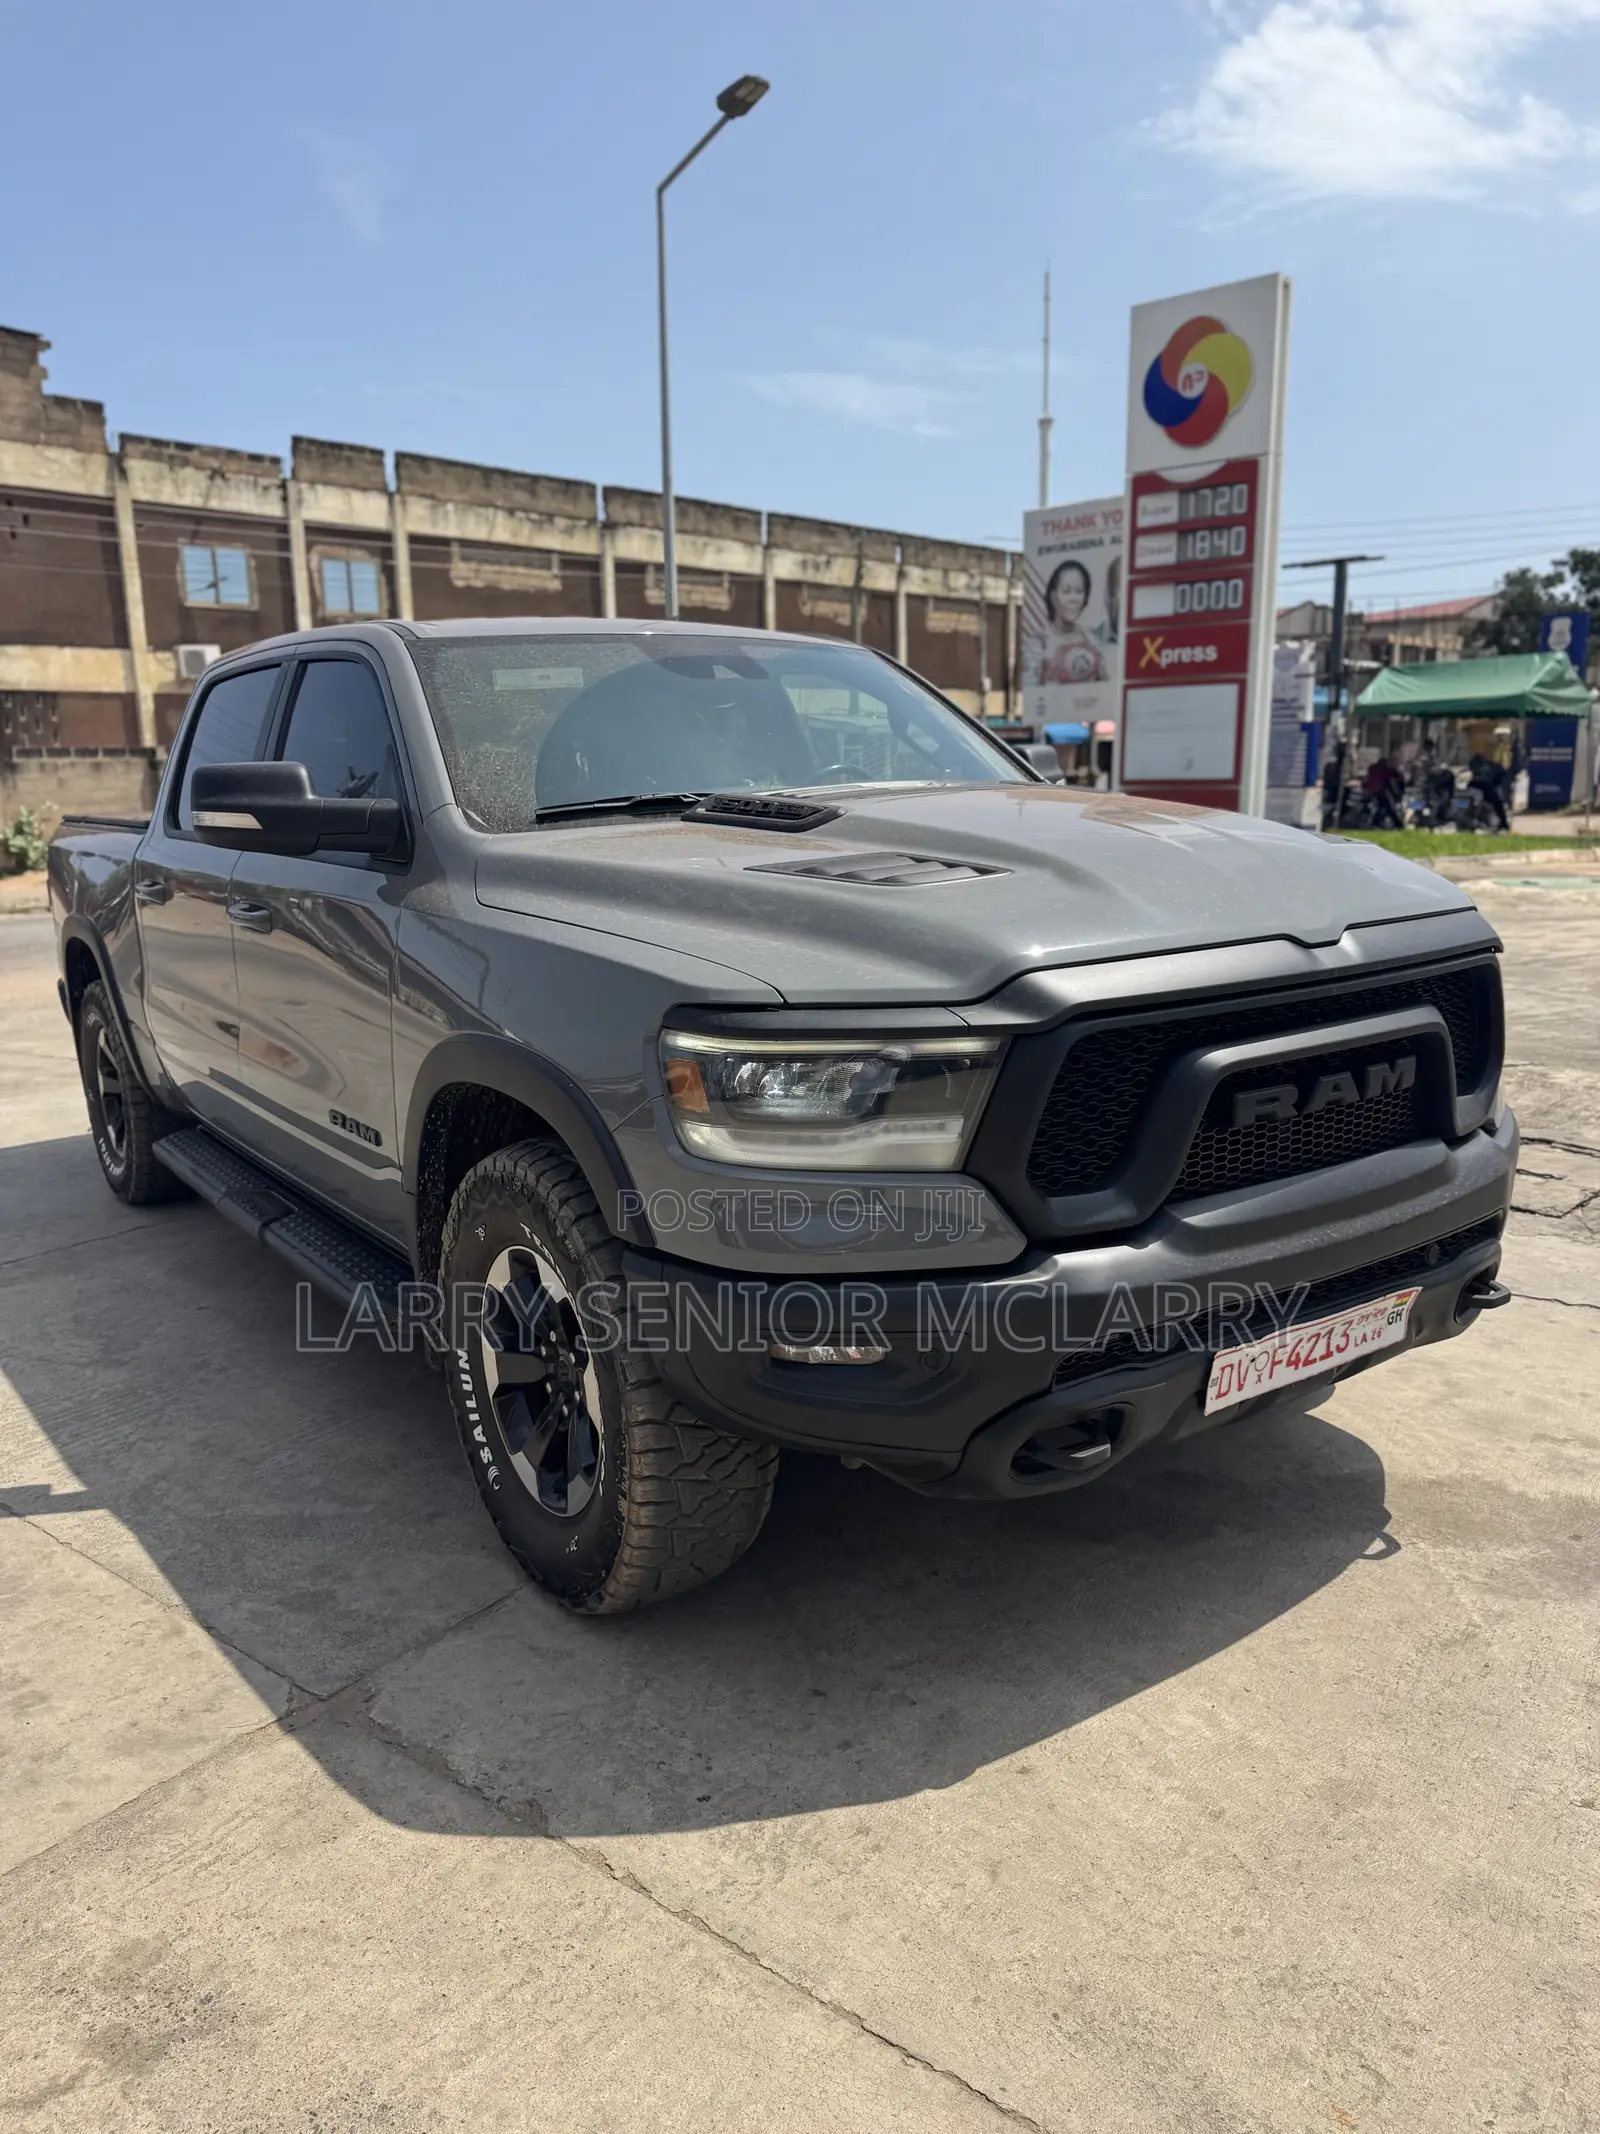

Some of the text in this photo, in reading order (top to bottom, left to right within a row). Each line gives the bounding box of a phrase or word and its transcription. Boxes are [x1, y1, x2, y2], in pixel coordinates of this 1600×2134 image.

[1041, 508, 1124, 537] THANK YO
[1138, 635, 1219, 670] Xpress
[1233, 1054, 1418, 1128] RAM
[328, 1108, 383, 1147] RAM
[1386, 1307, 1405, 1326] GH
[457, 1349, 494, 1465] SAILUN
